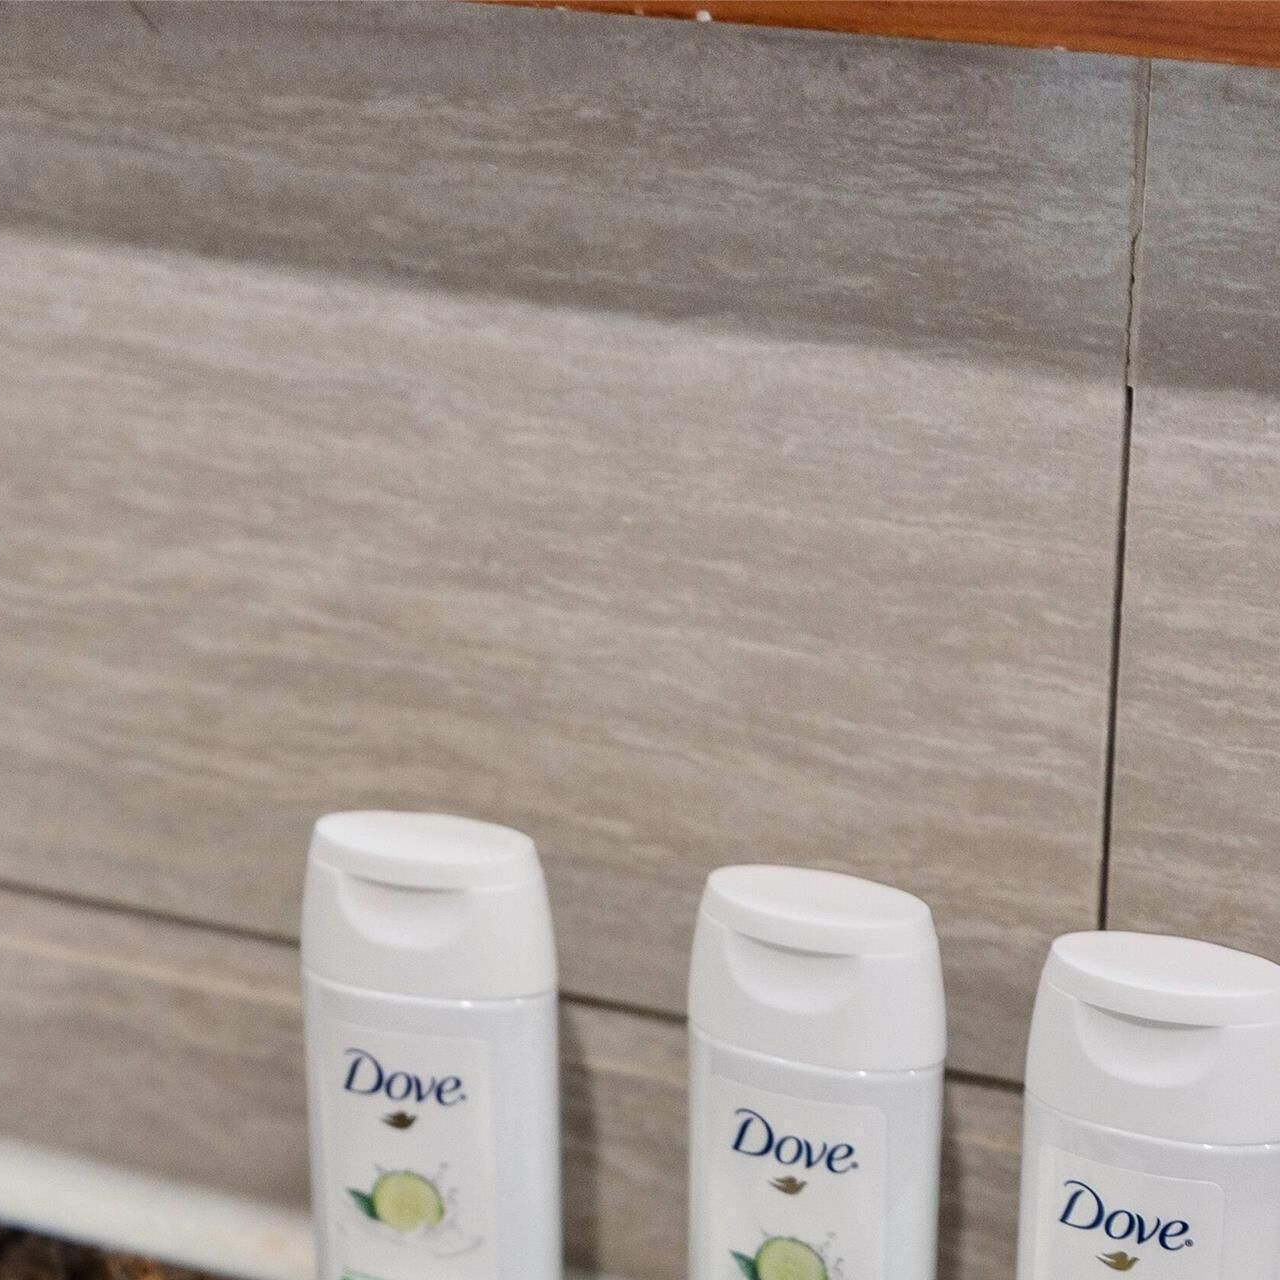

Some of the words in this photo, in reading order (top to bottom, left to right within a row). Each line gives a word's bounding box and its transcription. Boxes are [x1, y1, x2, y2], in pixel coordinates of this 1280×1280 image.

[343, 1048, 463, 1106] Dove
[731, 1108, 854, 1174] Dove
[1058, 1180, 1190, 1252] Dove
